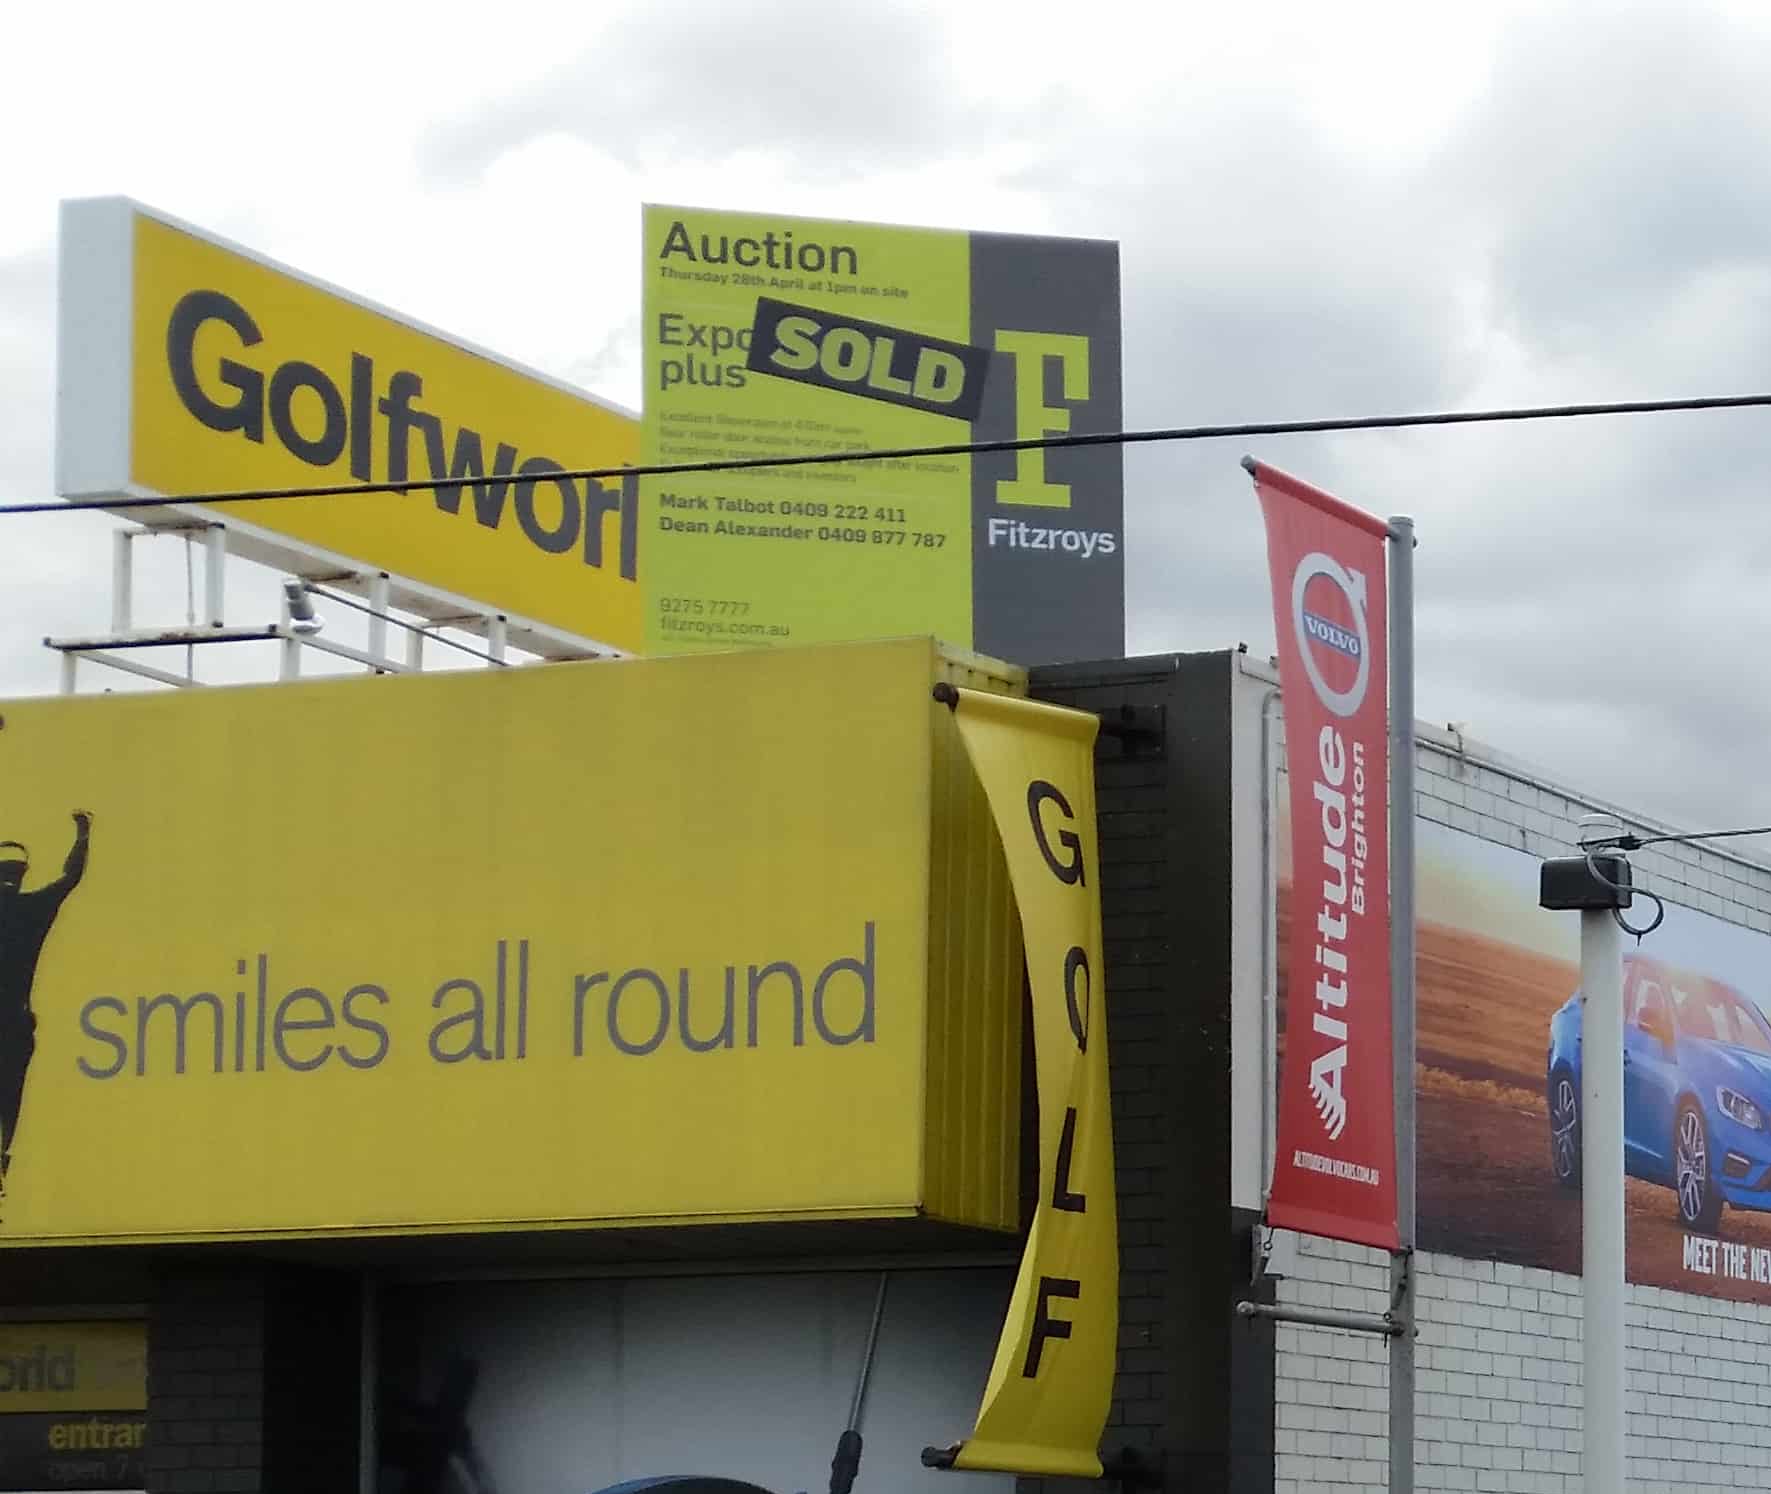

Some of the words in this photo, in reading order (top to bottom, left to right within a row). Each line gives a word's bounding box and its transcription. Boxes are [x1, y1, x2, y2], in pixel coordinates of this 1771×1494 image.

[659, 221, 858, 275] Auction
[660, 266, 728, 285] Thursday
[732, 273, 765, 287] 28th
[770, 275, 804, 292] April
[808, 279, 823, 291] at
[826, 281, 857, 296] 1pm
[860, 285, 878, 296] on
[882, 284, 909, 299] site
[659, 354, 747, 391] plus
[770, 314, 966, 403] SOLD
[659, 493, 709, 511] Mark
[714, 496, 775, 514] Talbot
[780, 500, 829, 518] 0409
[834, 504, 869, 520] 222
[874, 507, 906, 523] 411
[659, 516, 709, 534] Dean
[714, 519, 810, 541] Alexander
[818, 526, 867, 543] 0409
[871, 530, 906, 546] 877
[912, 533, 946, 549] 787
[987, 518, 1117, 559] Fitzroys
[660, 615, 791, 637] fitzroys.com.au
[709, 600, 752, 617] 7777
[1305, 615, 1360, 655] VOLVO
[1352, 742, 1369, 916] Brighton
[1309, 725, 1348, 1141] Altitude
[75, 952, 390, 1082] smiles
[429, 938, 529, 1064] all
[573, 920, 877, 1058] round
[1022, 778, 1090, 1379] GOLF
[1682, 1234, 1719, 1275] MEET
[1722, 1242, 1748, 1281] THE
